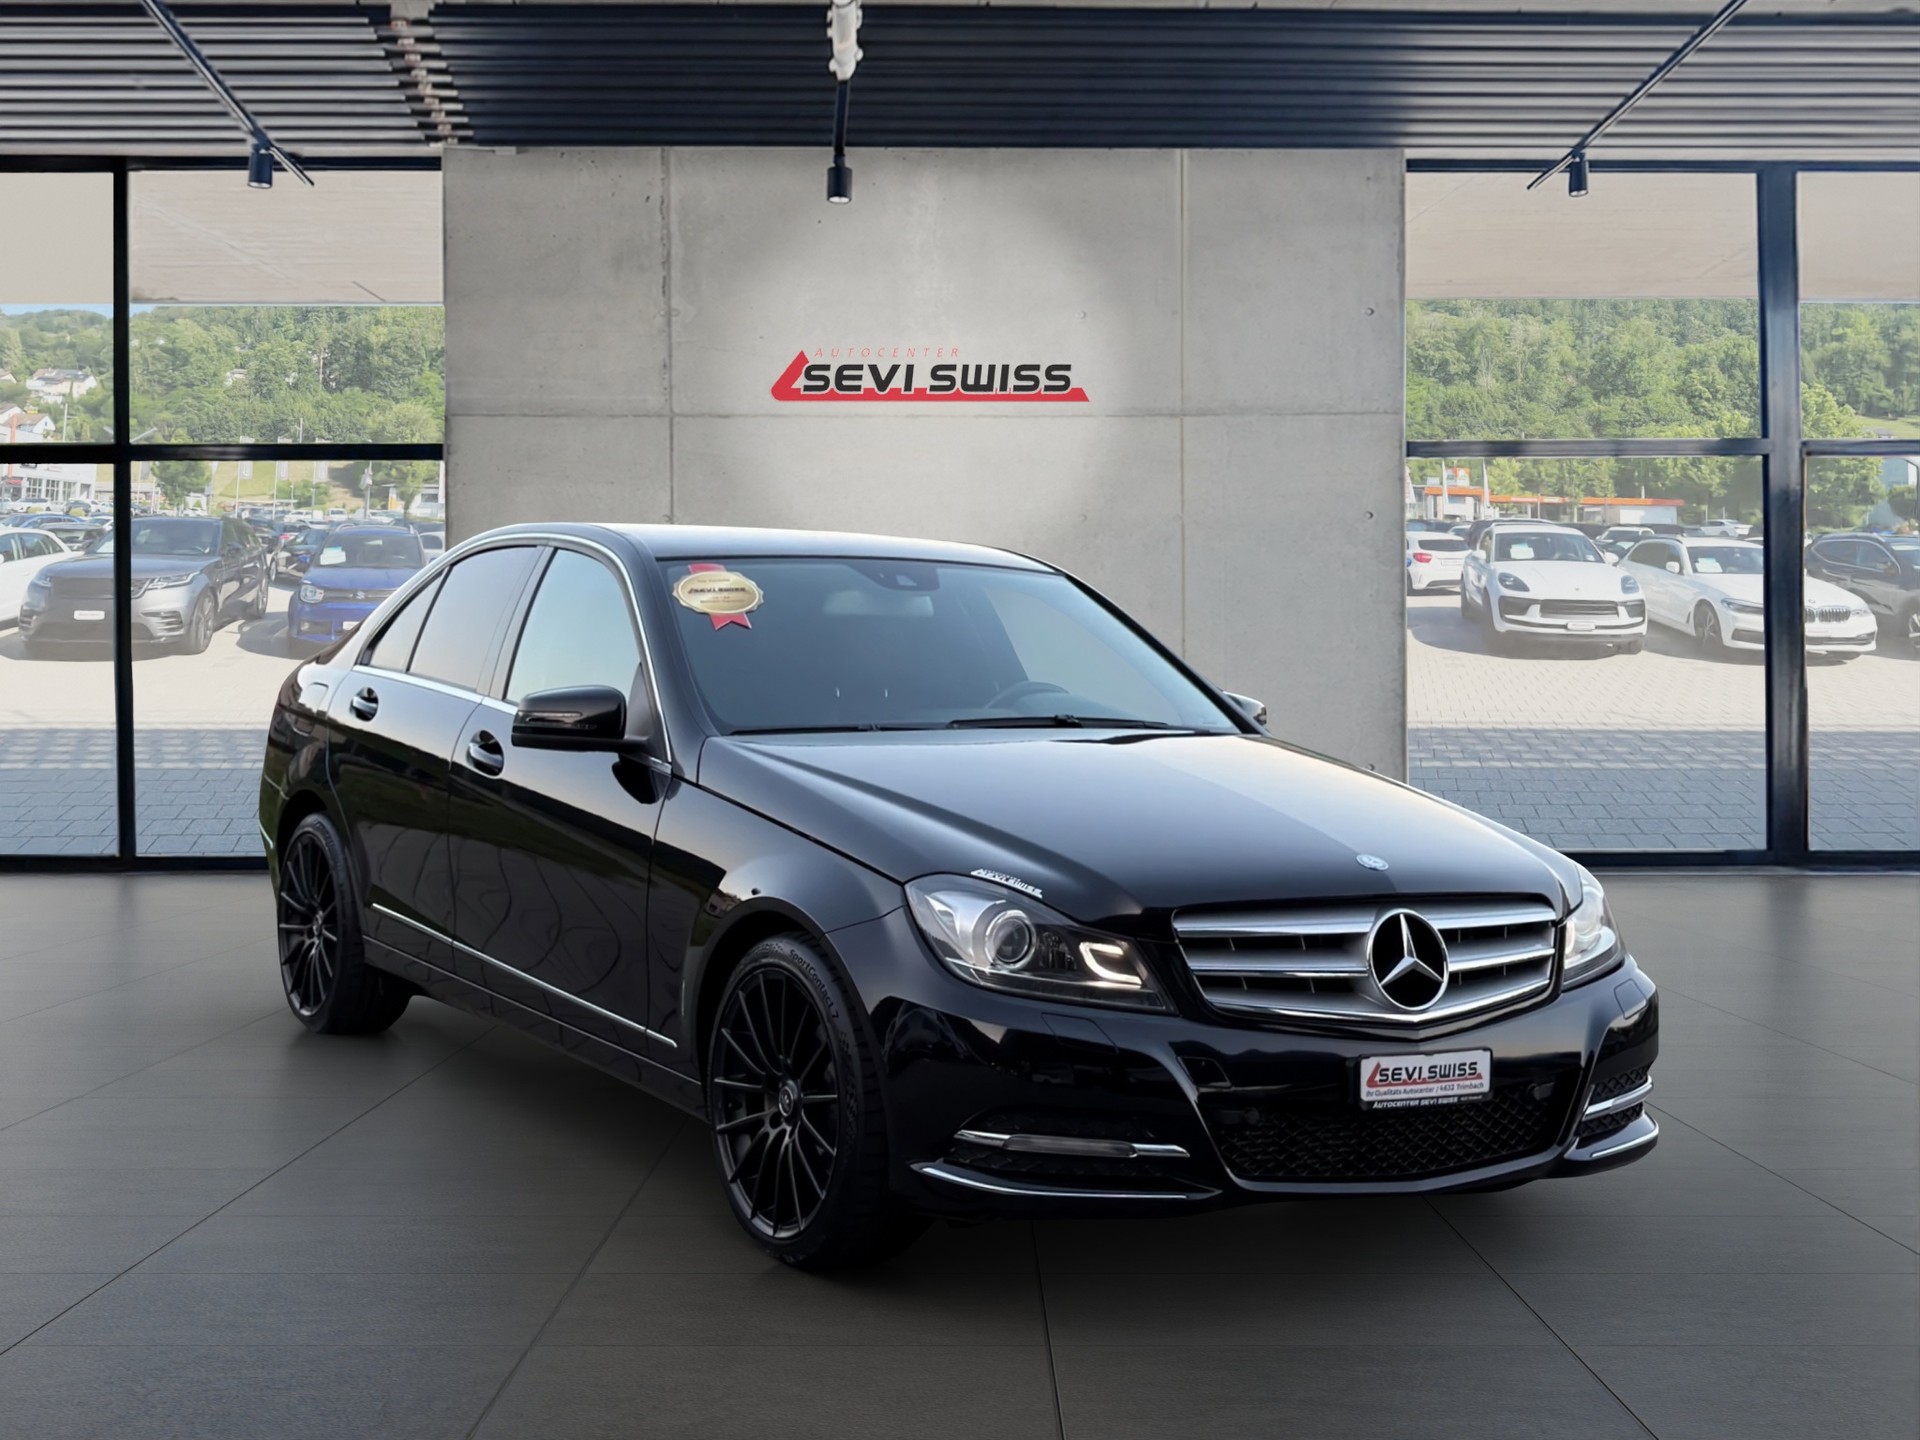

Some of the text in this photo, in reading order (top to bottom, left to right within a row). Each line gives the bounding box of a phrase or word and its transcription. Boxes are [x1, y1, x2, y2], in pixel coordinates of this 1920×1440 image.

[814, 347, 960, 358] AUTOCENTER
[802, 364, 1072, 393] SEVI SWISS
[789, 948, 835, 1009] SportContact
[1379, 1061, 1478, 1082] SEVI SWISS
[1402, 1086, 1435, 1095] Autocenter
[1456, 1081, 1484, 1092] Trimbach
